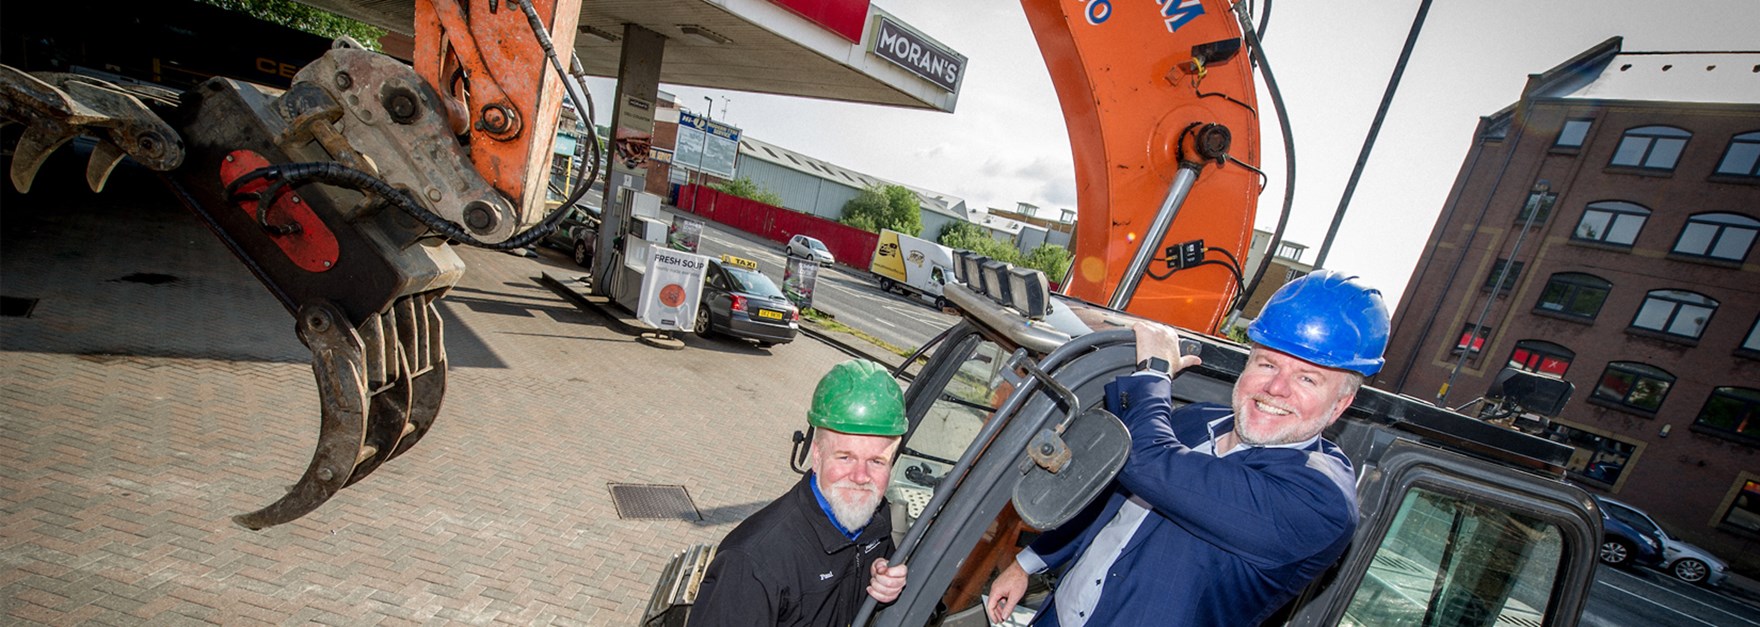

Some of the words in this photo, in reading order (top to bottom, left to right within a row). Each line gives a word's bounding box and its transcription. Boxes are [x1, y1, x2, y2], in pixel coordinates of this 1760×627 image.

[880, 27, 957, 84] MORAN'S
[654, 254, 681, 266] FRESH
[682, 259, 705, 270] SOUP
[735, 258, 756, 268] TAXI
